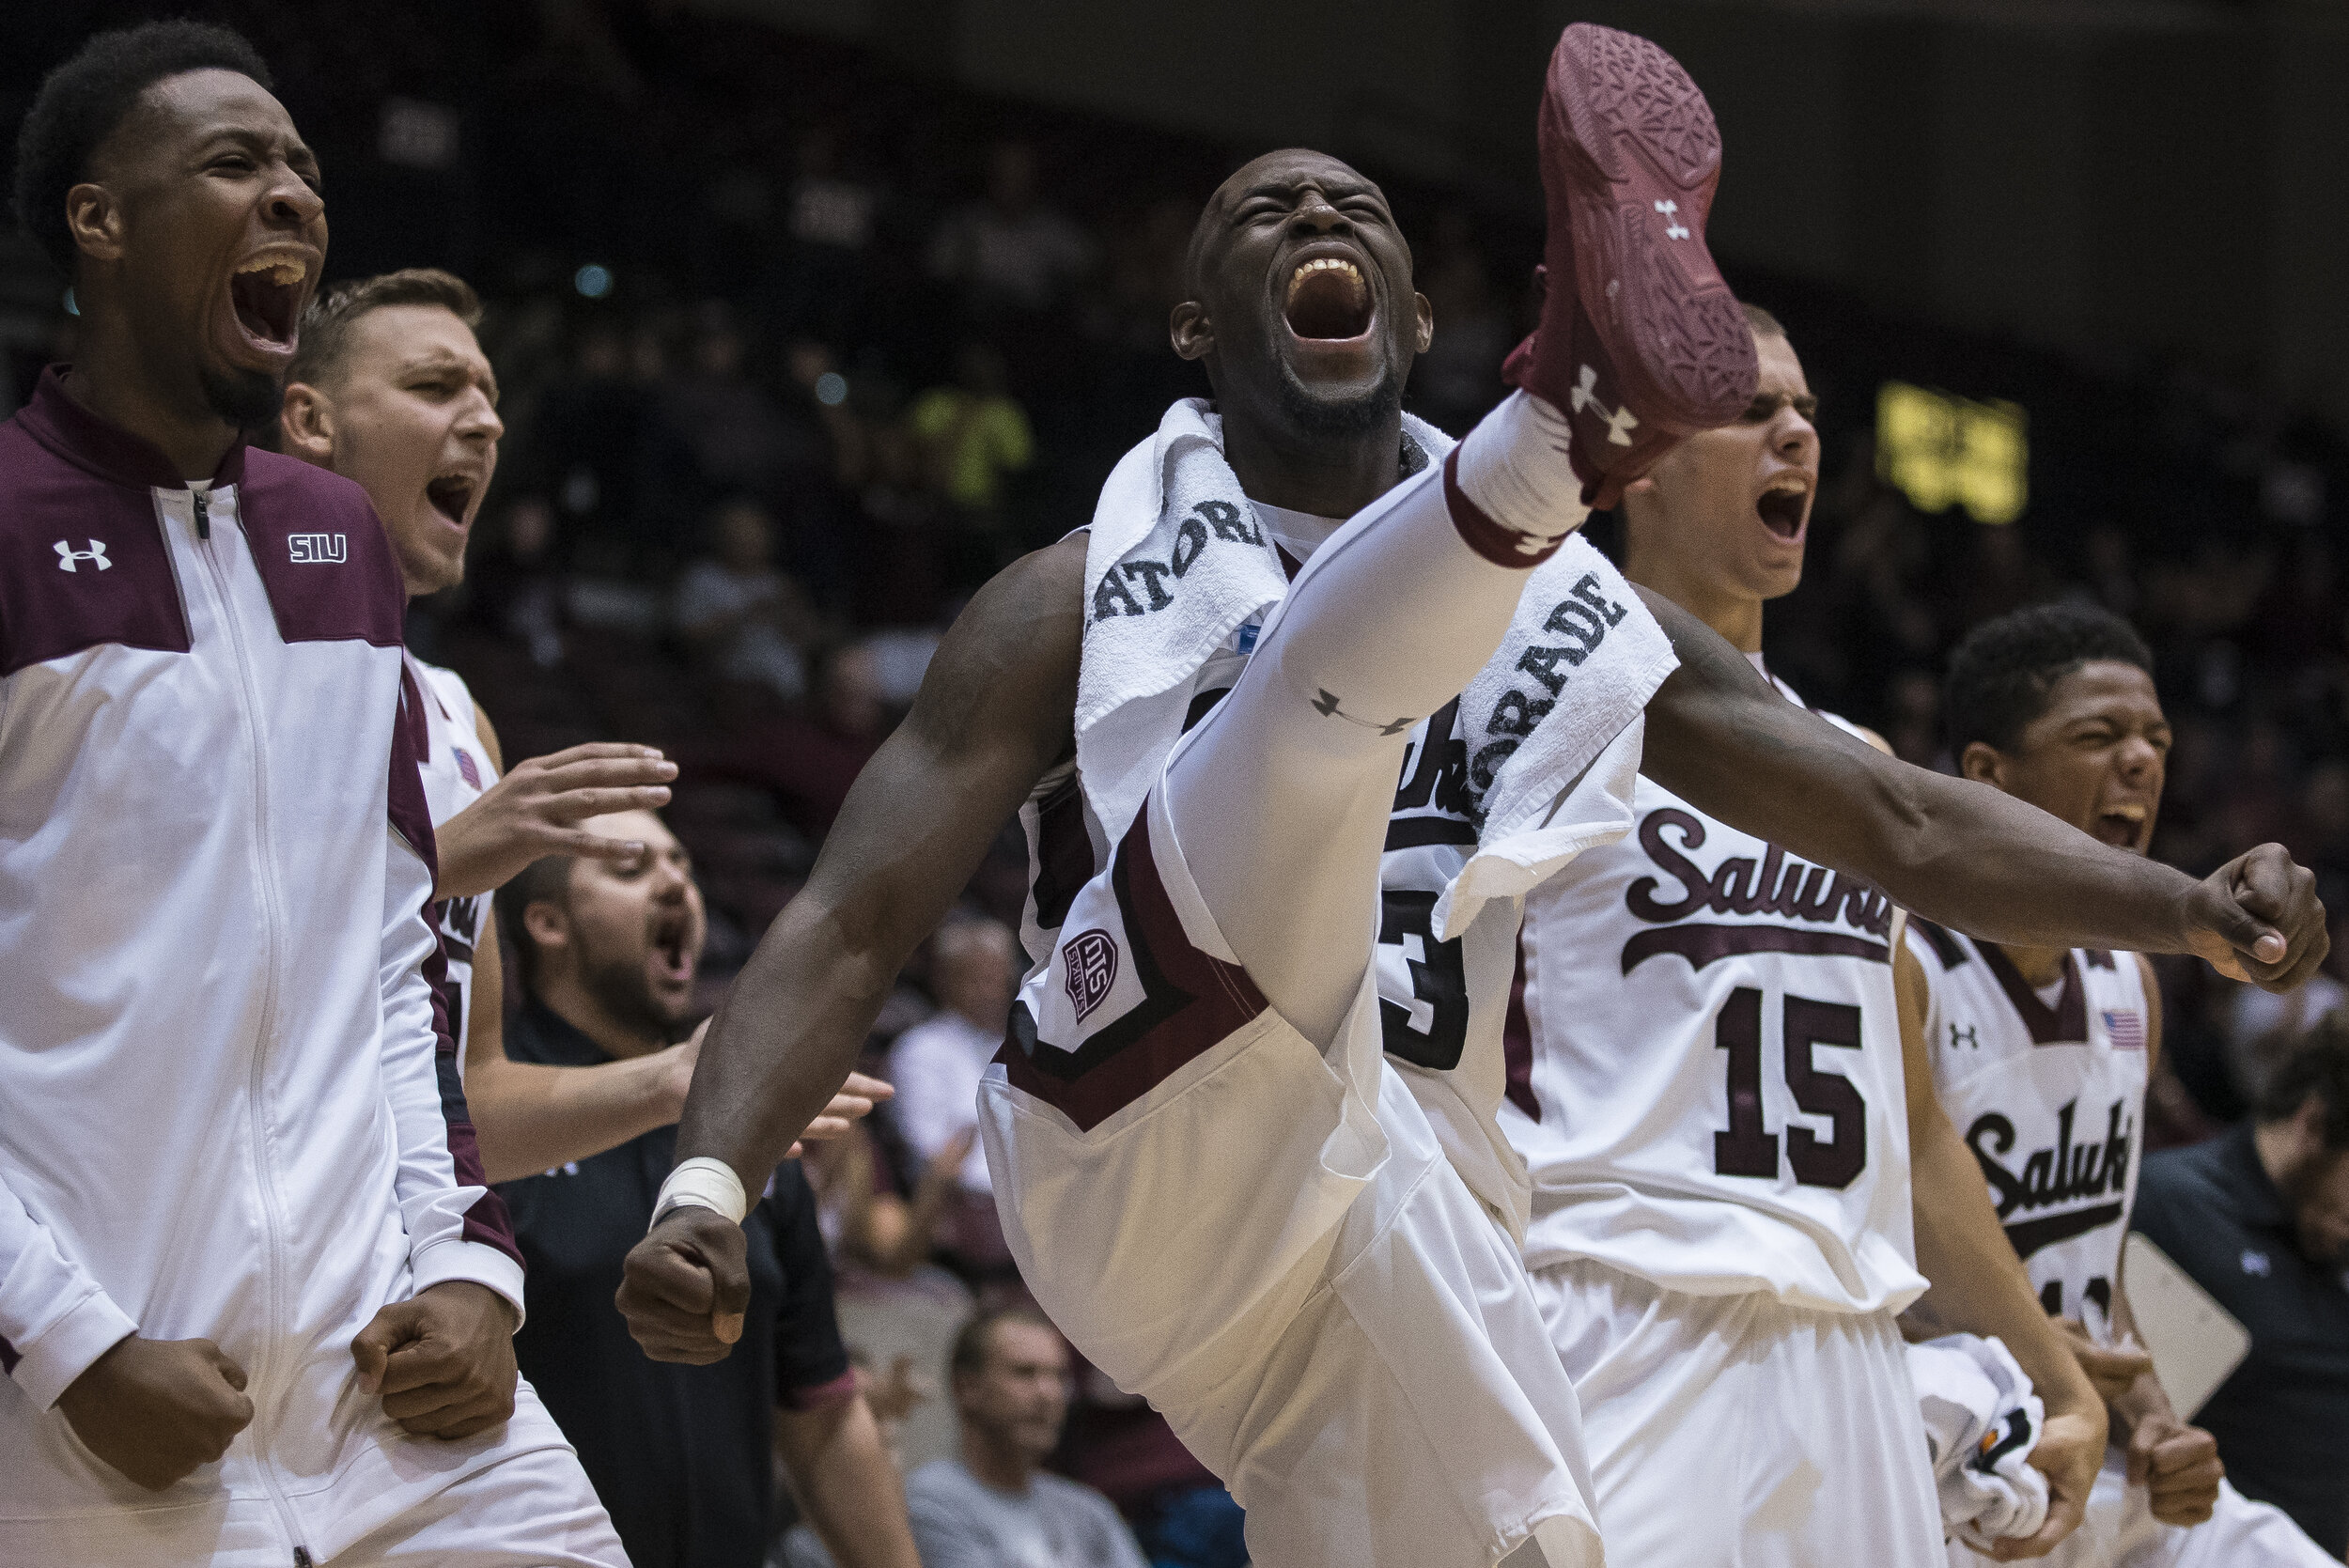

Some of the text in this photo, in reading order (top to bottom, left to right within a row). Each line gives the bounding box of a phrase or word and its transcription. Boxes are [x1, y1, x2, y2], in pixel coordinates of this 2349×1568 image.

[288, 533, 347, 564] SIU
[1086, 500, 1267, 639] ATOR
[1468, 570, 1628, 829] ORADE
[1068, 950, 1085, 1011] SALUKIS
[1084, 938, 1108, 994] SIU
[1714, 986, 1866, 1190] 15
[1965, 1097, 2132, 1221] Saluk
